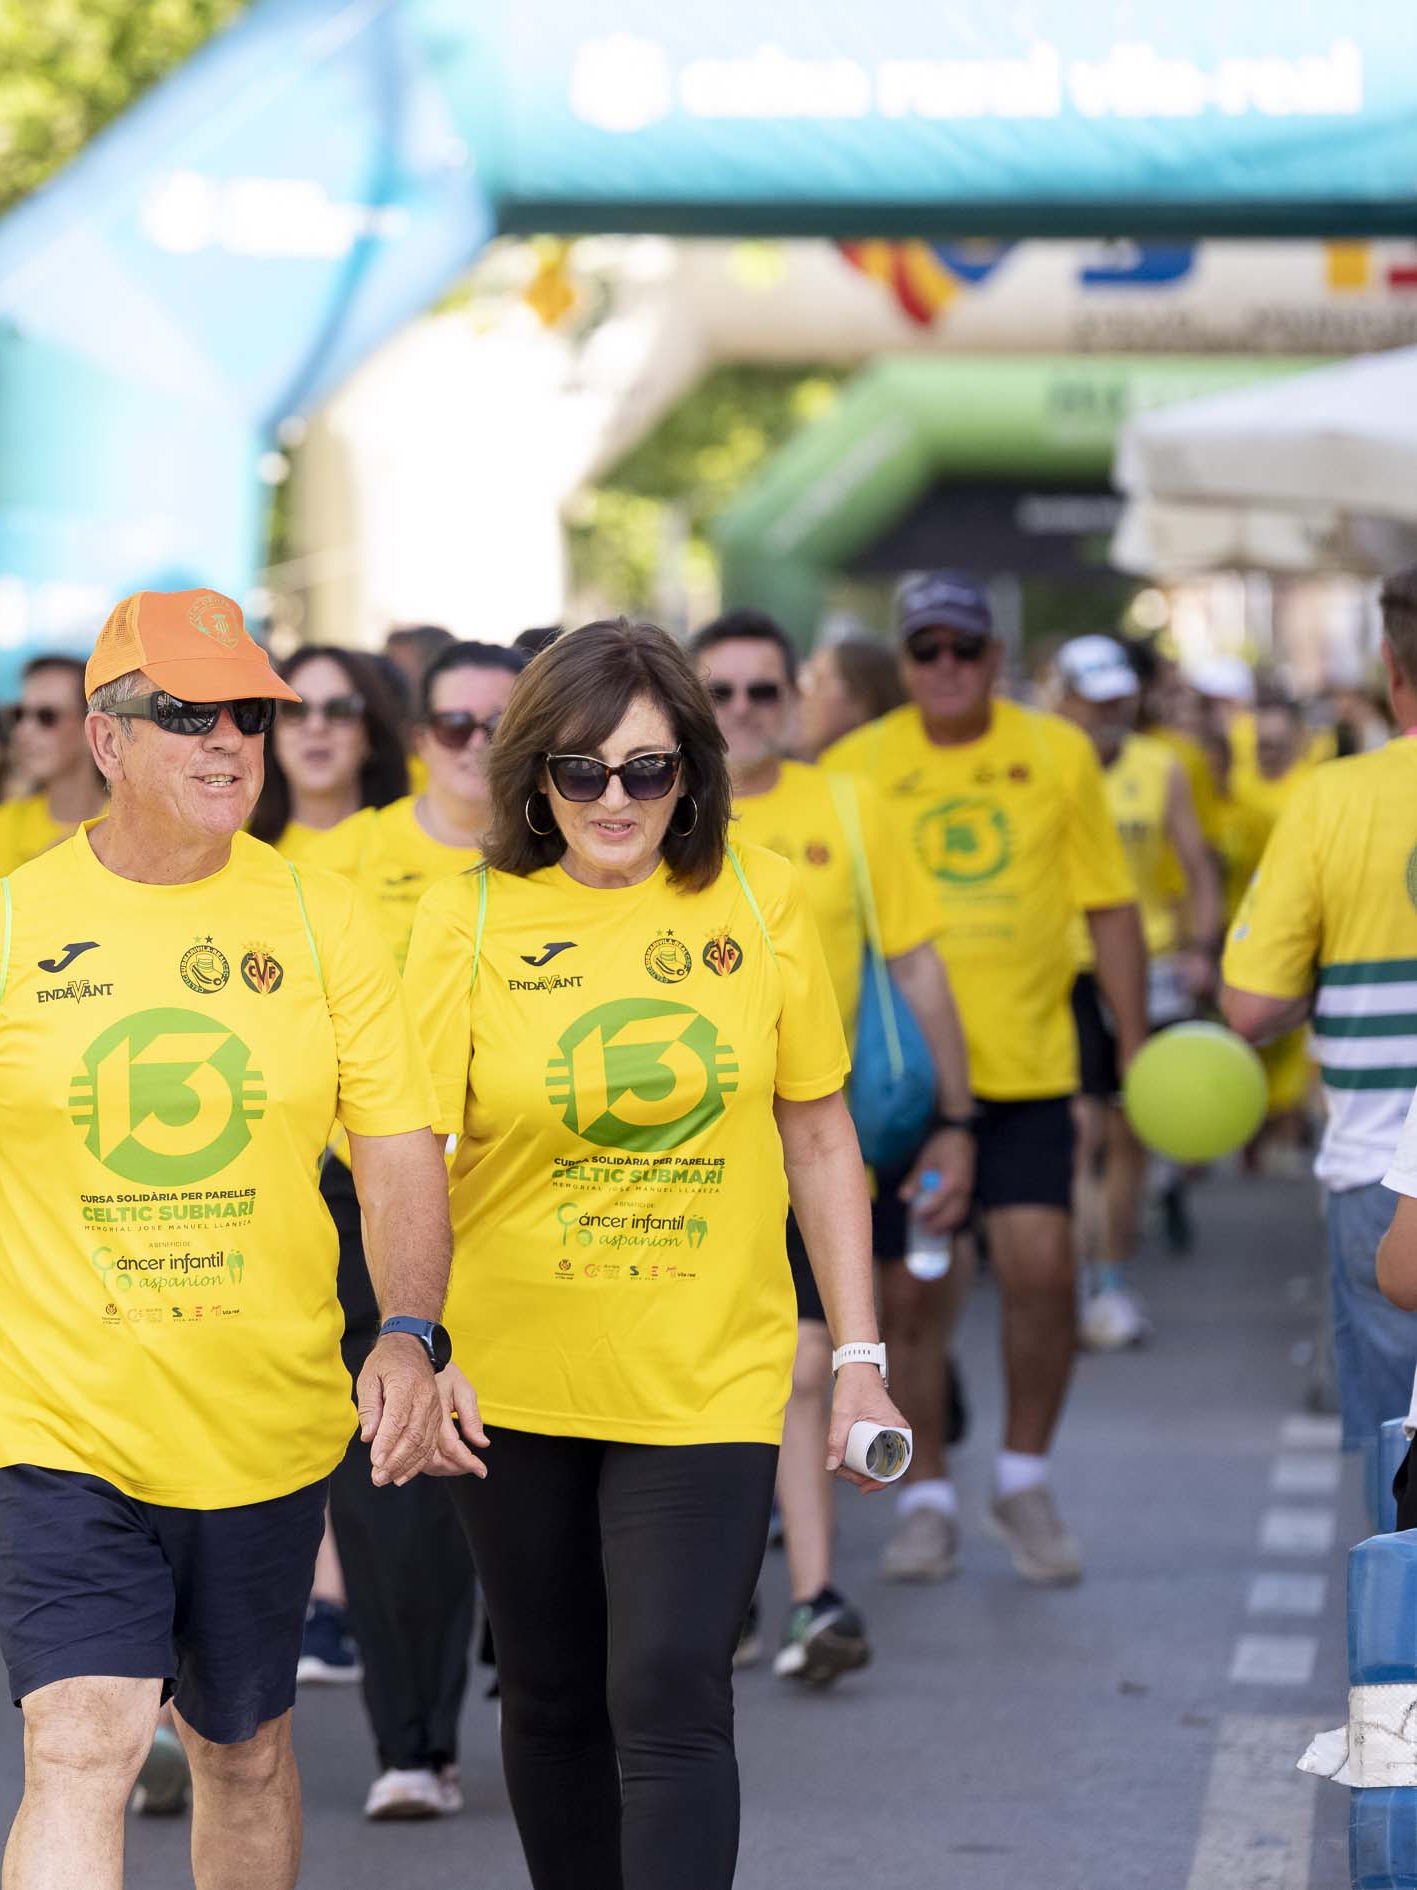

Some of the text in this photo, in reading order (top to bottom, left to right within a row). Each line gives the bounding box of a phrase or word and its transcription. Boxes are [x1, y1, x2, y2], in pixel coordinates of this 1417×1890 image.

[36, 980, 114, 1004] ENDAVANT
[508, 974, 583, 994] ENDAVANT
[591, 1156, 649, 1166] SOLIDÀRIA
[653, 1157, 672, 1166] PER
[675, 1158, 725, 1167] PARELLES
[629, 1165, 725, 1185] SUBMARÍ
[80, 1188, 256, 1204] CURSA SOLIDÀRIA PER PARELLES
[82, 1197, 255, 1223] CELTIC SUBMARÍ
[631, 1213, 685, 1233] infantil
[599, 1233, 683, 1250] aspanion
[170, 1251, 223, 1274] infantil
[139, 1274, 224, 1292] aspanion
